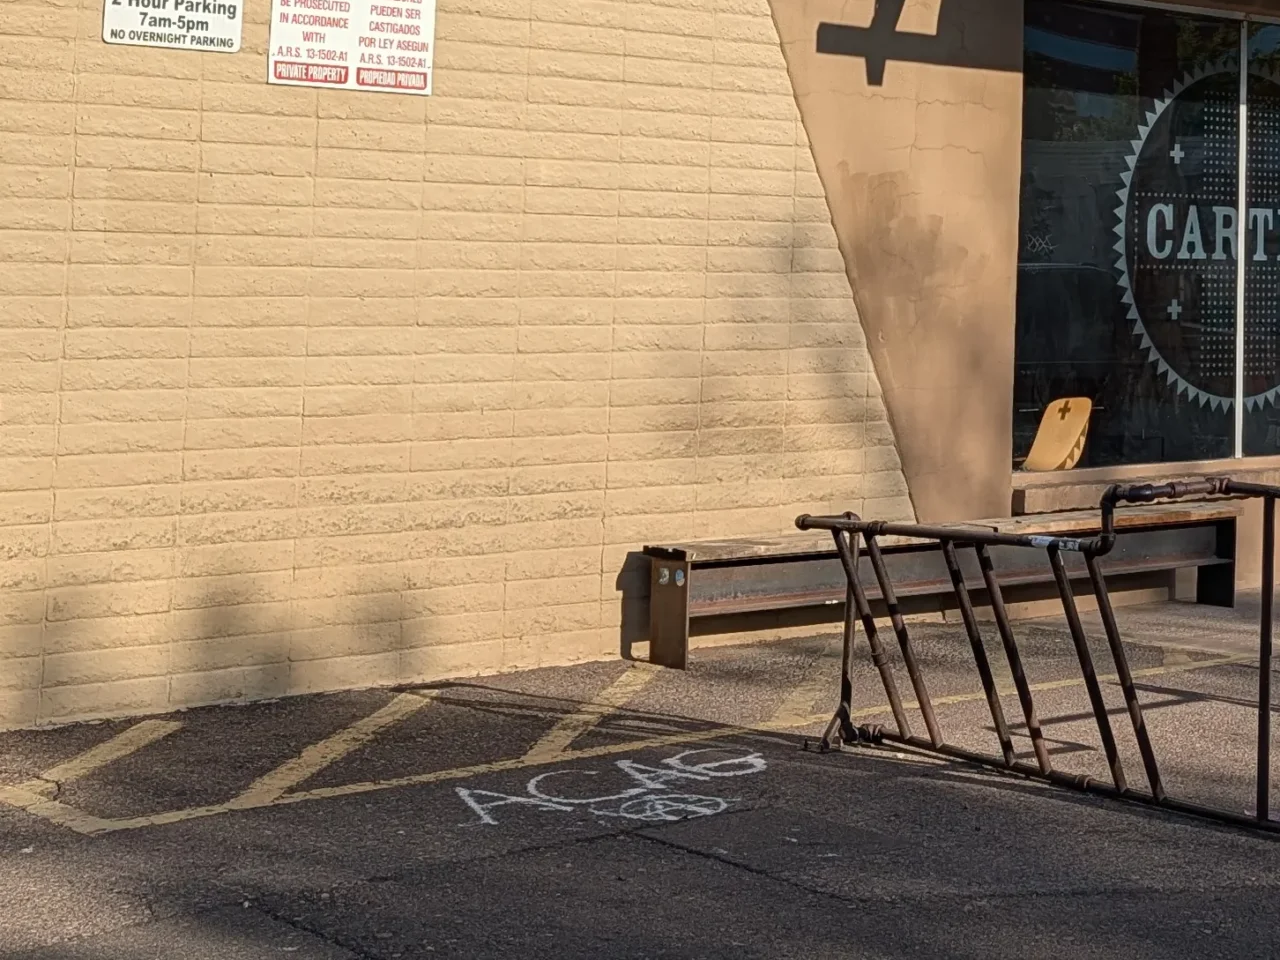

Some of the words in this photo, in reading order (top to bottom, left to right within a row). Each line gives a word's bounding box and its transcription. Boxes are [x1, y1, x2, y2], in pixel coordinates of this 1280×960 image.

[280, 12, 289, 23] IN
[291, 13, 349, 29] ACCORDANCE
[370, 5, 402, 19] PUEDEN
[405, 8, 421, 20] SER
[139, 12, 209, 33] 7am-5pm
[369, 21, 420, 36] CASTIGADOS
[110, 29, 125, 39] NO
[128, 30, 188, 44] OVERNIGHT
[190, 35, 234, 48] PARKING
[302, 31, 326, 43] WITH
[359, 36, 376, 48] POR
[378, 38, 394, 49] LEY
[396, 40, 429, 52] ASEGUN
[276, 63, 307, 79] PRIVATE
[308, 65, 347, 82] PROPERTY
